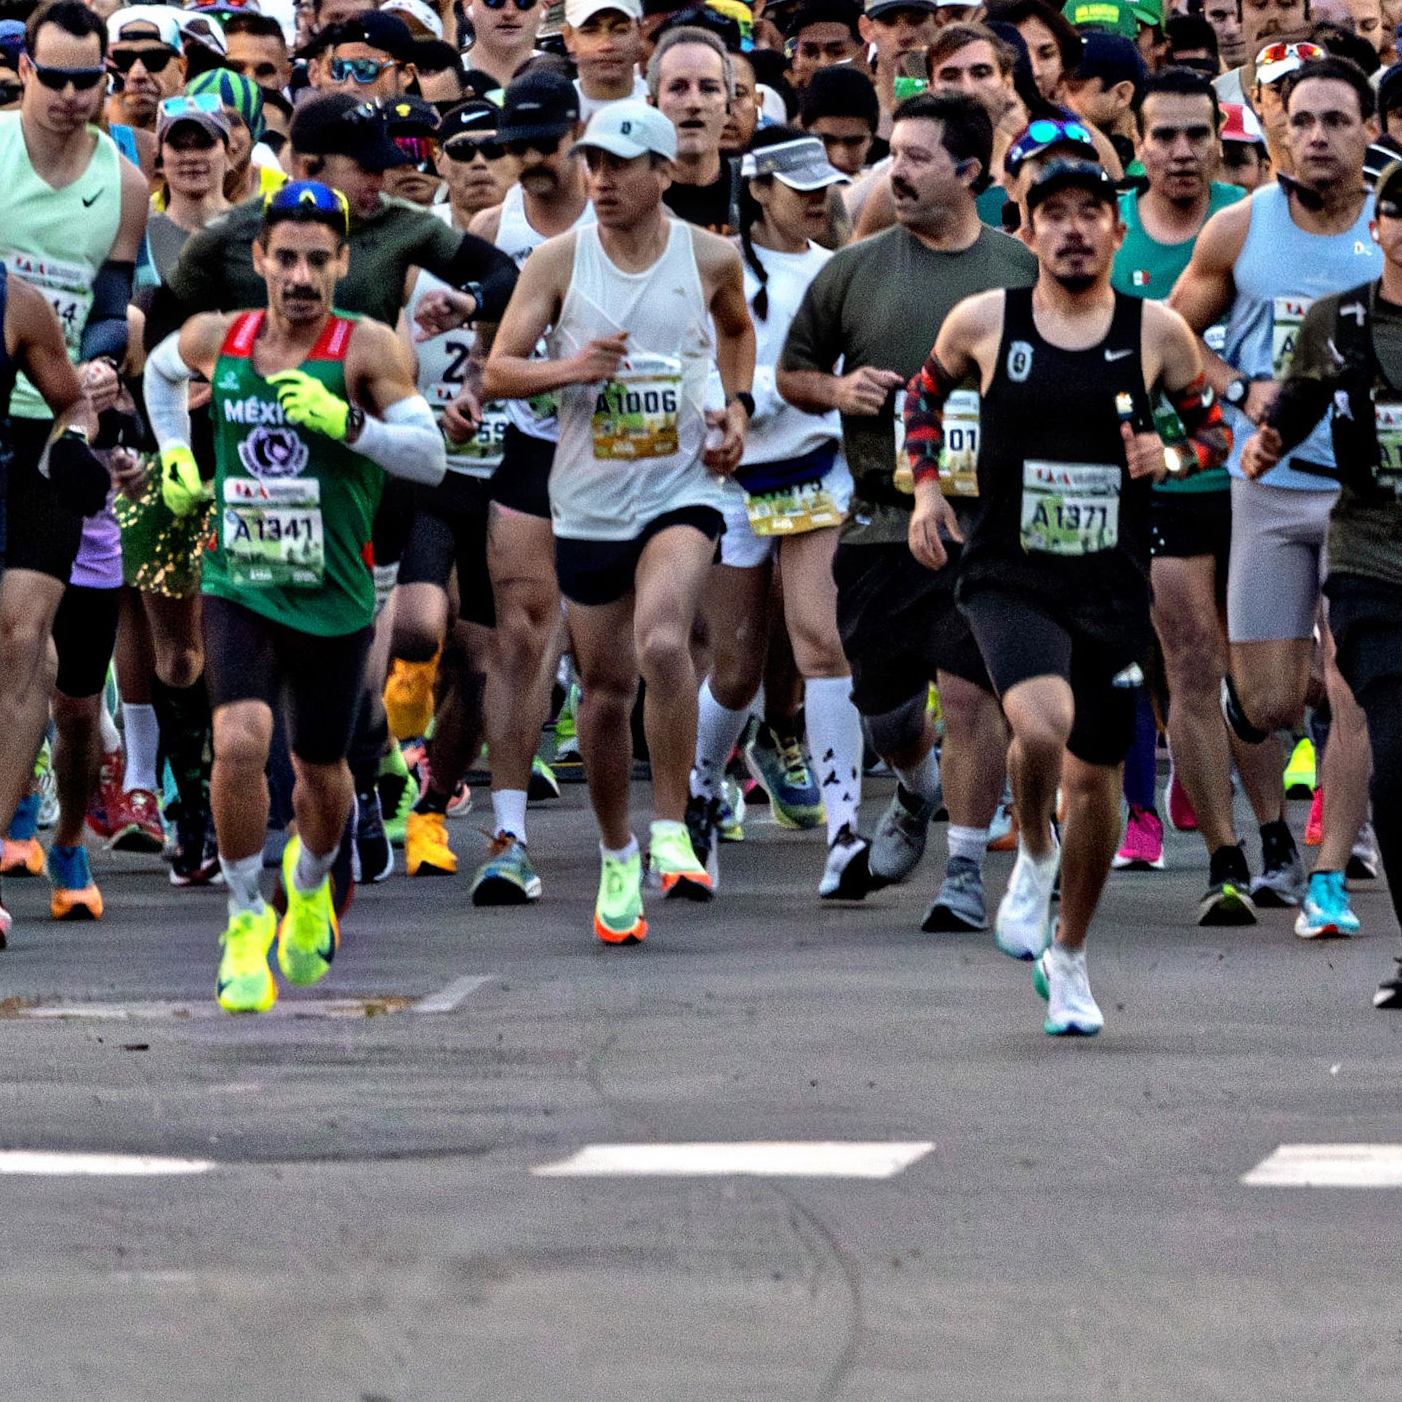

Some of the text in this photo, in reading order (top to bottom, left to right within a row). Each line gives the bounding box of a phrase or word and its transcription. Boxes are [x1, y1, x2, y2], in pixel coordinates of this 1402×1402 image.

[225, 393, 293, 425] MÉXI
[595, 390, 677, 416] A1006
[234, 518, 313, 542] A1341
